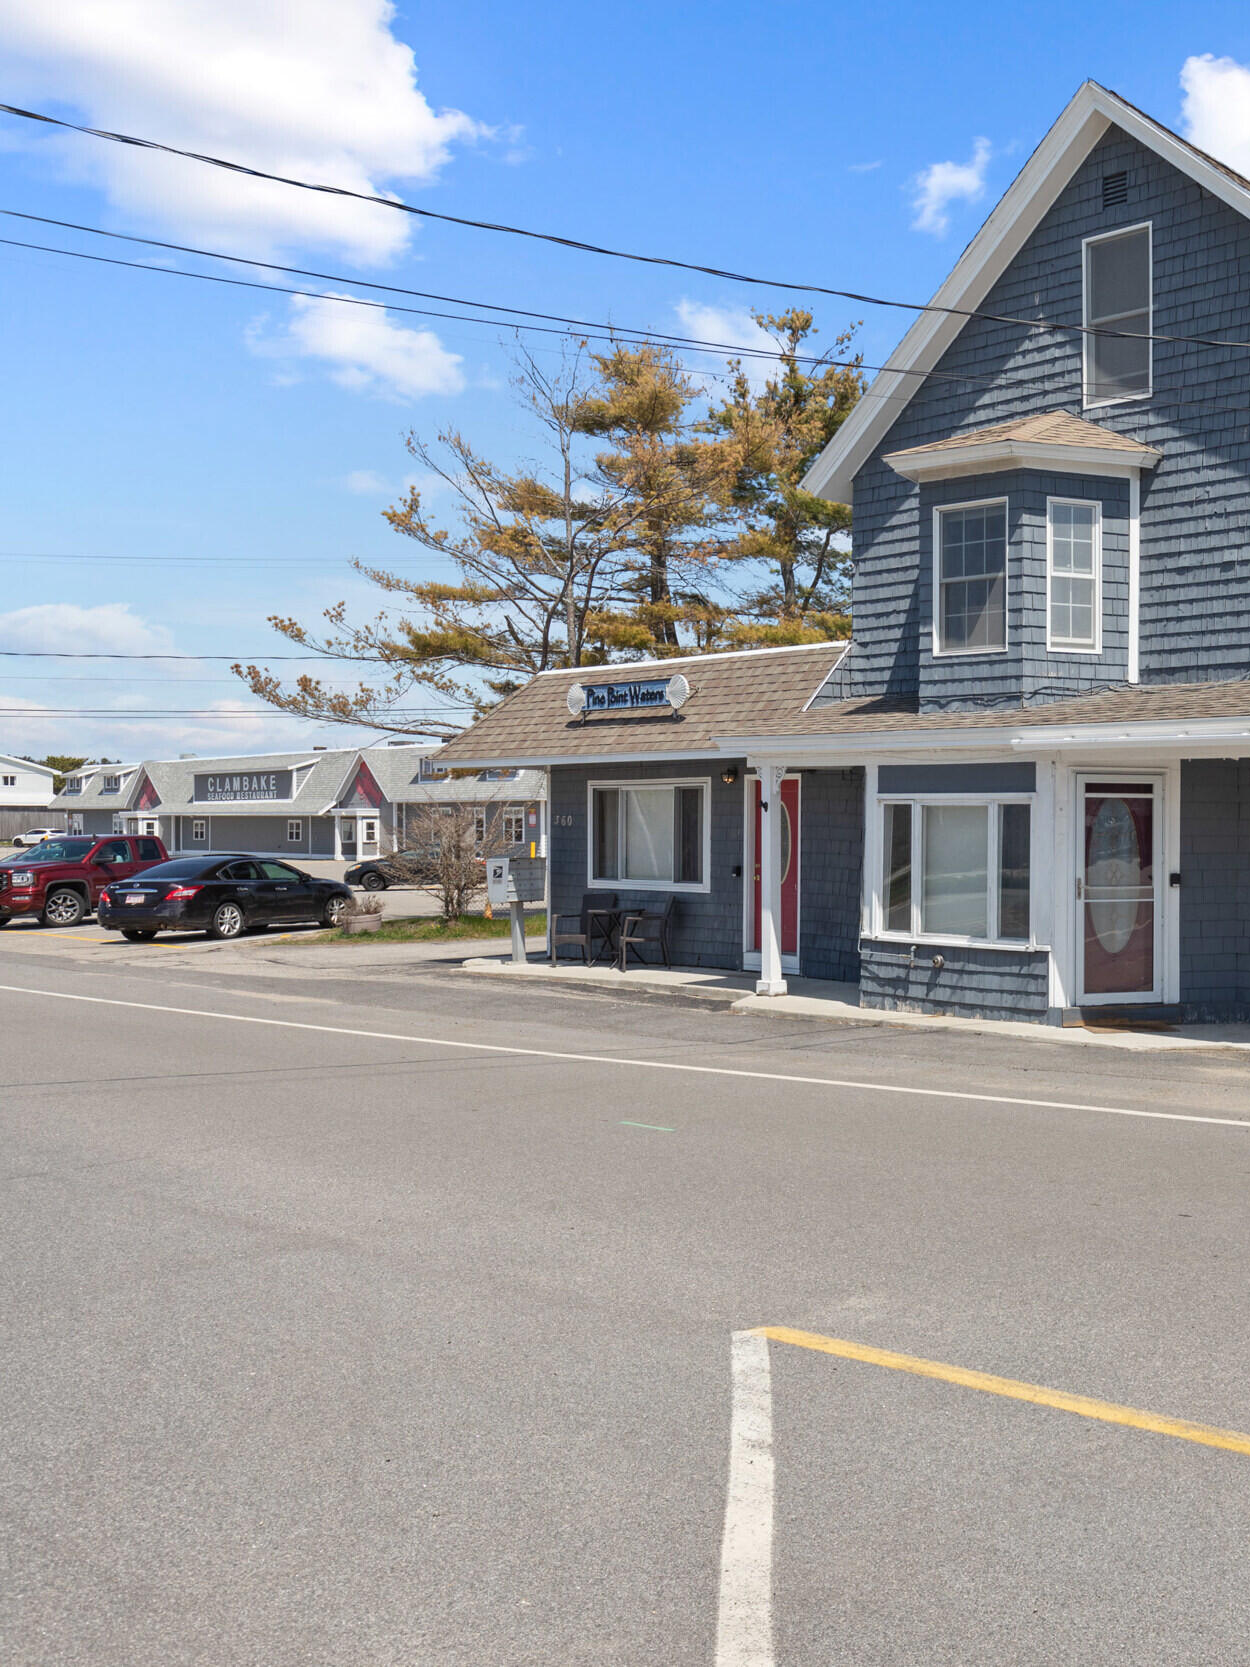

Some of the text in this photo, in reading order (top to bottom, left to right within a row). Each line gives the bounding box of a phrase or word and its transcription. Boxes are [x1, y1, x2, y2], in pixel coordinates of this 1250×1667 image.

[587, 684, 664, 709] Pine Point Waters
[207, 775, 277, 792] CLAMBAKE
[207, 790, 277, 801] SEAFOOD RESTAURANT
